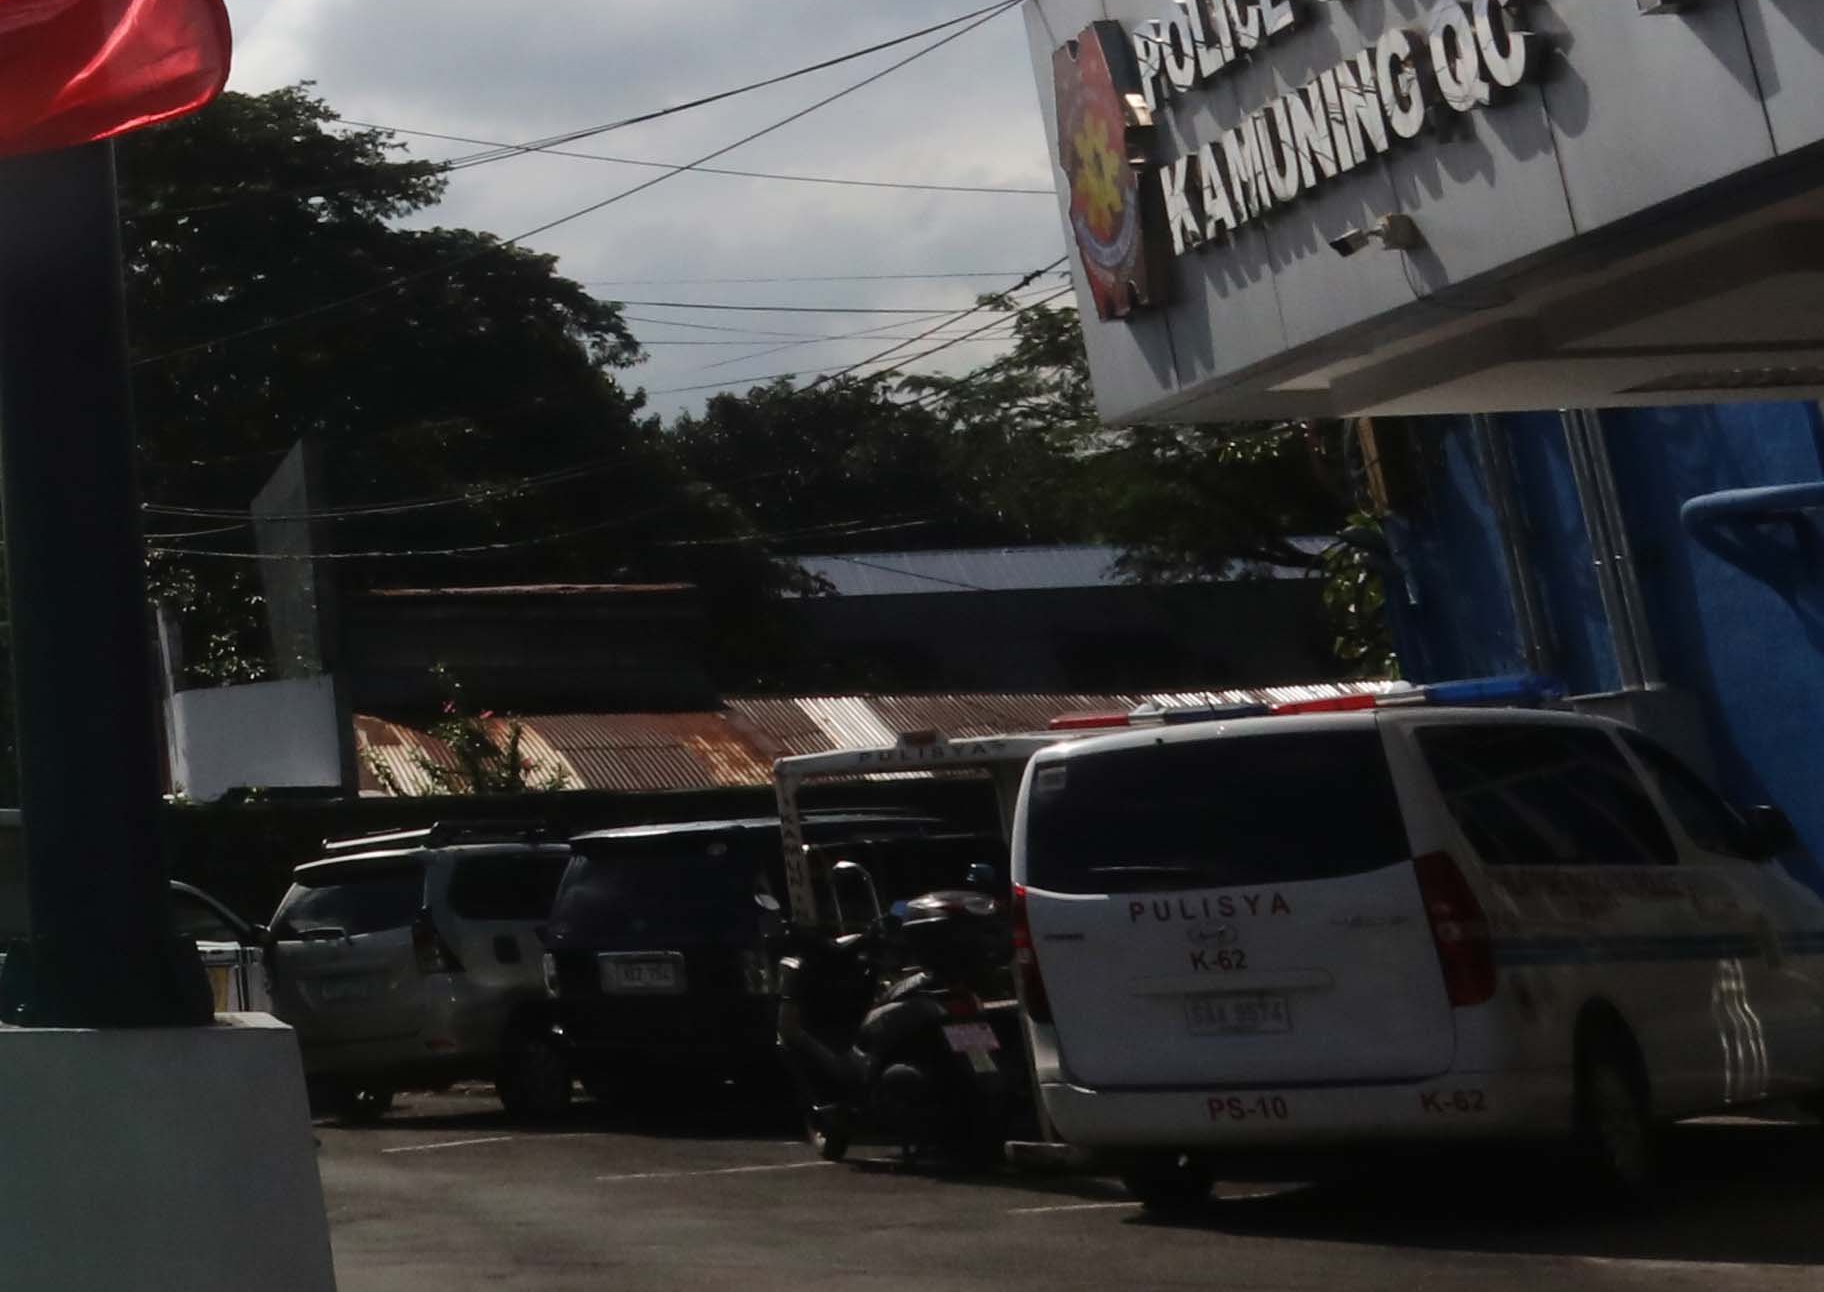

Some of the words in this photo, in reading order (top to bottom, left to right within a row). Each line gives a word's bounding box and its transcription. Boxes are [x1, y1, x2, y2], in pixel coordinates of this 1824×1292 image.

[1159, 33, 1424, 257] KAMUNING
[1128, 892, 1292, 922] PULISYA
[1189, 948, 1249, 972] K-62
[1207, 1096, 1288, 1121] PS-10
[1419, 1088, 1487, 1115] K-62
